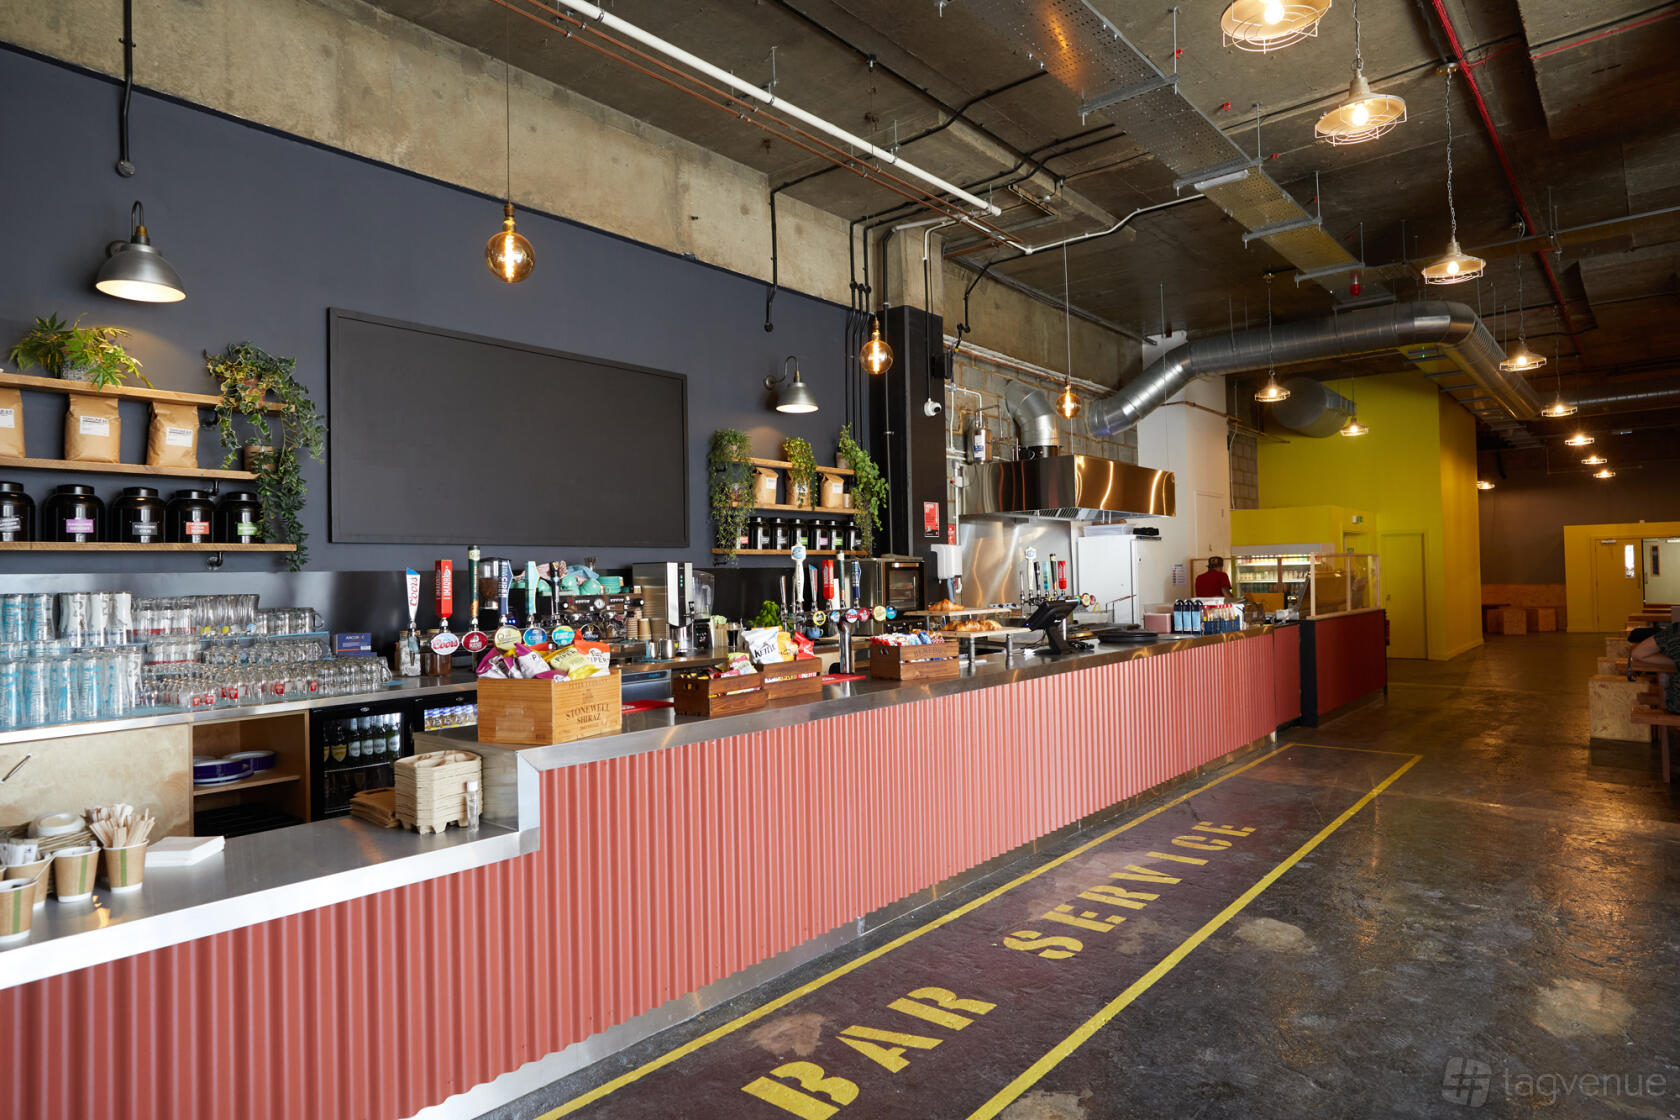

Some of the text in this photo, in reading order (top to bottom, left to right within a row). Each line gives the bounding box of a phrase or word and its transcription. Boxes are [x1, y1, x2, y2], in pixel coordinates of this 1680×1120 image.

[410, 577, 419, 607] Coors
[432, 639, 458, 650] Coors
[754, 644, 776, 658] KETTLE
[565, 703, 610, 719] STONEWELL
[576, 713, 601, 725] SHIRAZ
[741, 821, 1257, 1120] BAR SERVICE
